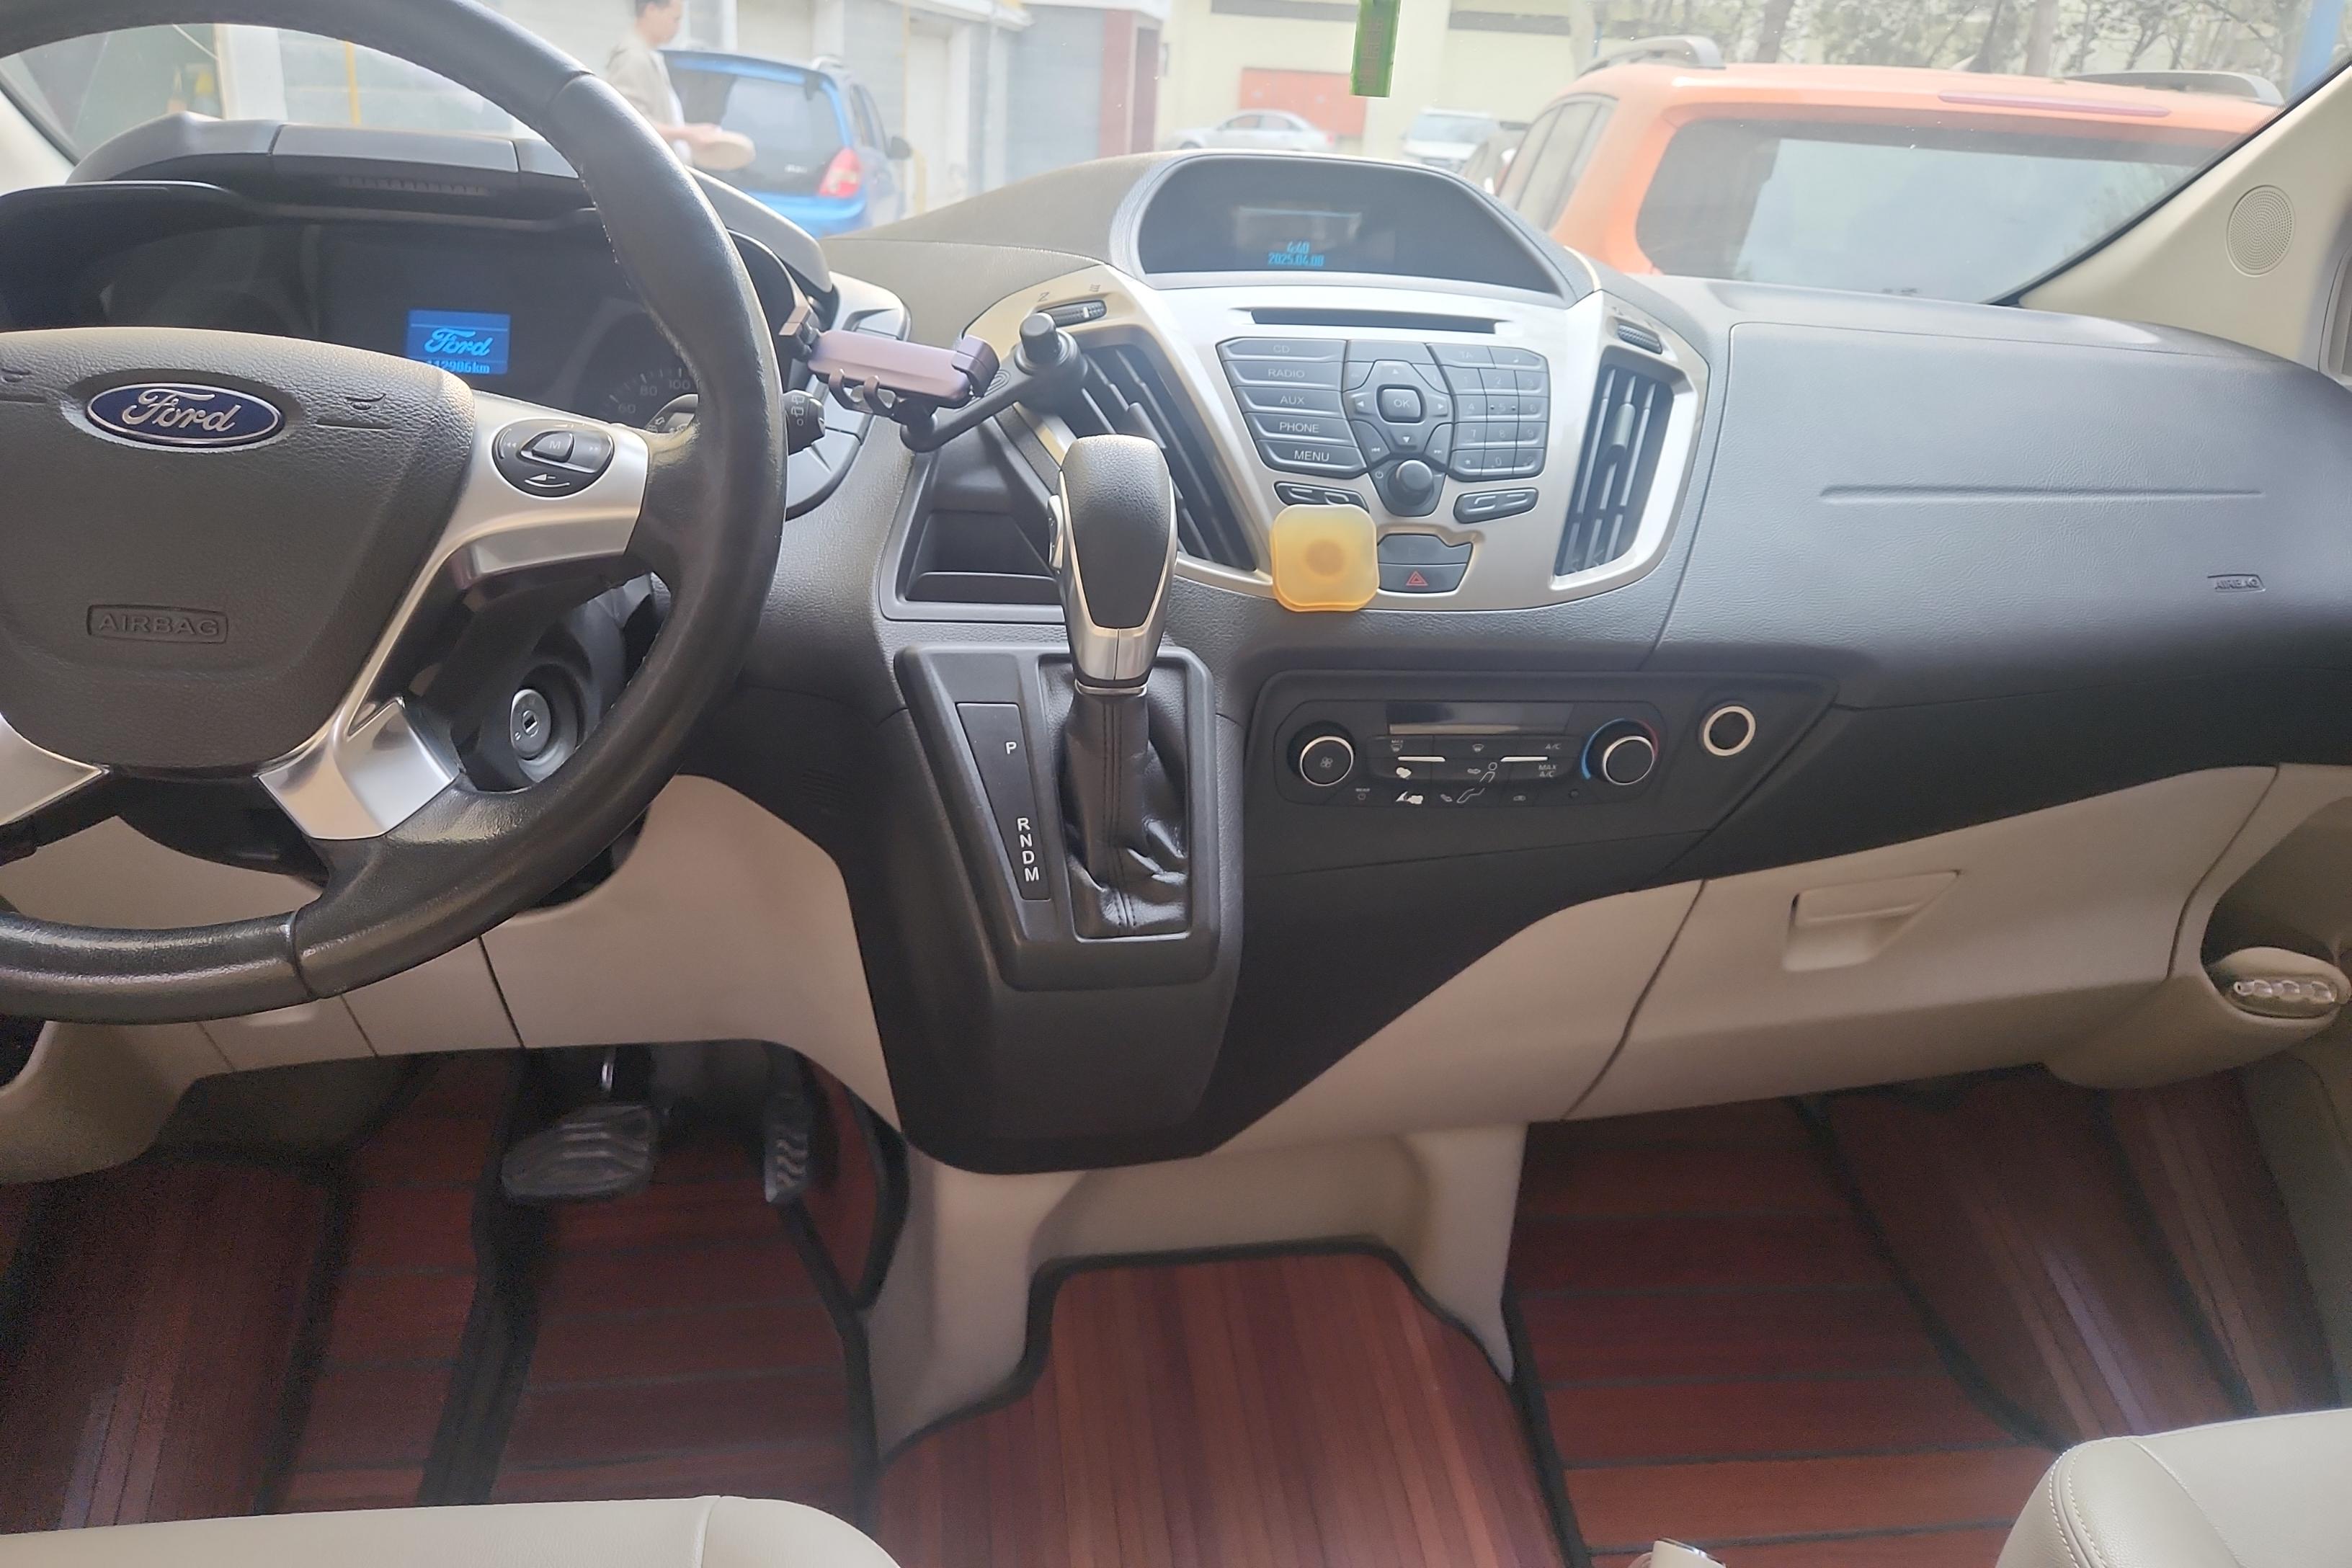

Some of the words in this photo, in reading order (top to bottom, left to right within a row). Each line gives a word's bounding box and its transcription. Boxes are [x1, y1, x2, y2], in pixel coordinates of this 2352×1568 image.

[424, 328, 493, 356] Ford
[1273, 345, 1291, 354] CD
[1268, 368, 1305, 378] RADIO
[669, 379, 690, 391] 100
[1495, 376, 1502, 386] 2
[640, 385, 658, 396] 80
[1280, 396, 1305, 405] AUX
[1393, 398, 1410, 408] OK
[122, 388, 241, 432] Ford
[1279, 422, 1320, 433] PHONE
[1471, 429, 1476, 438] 7
[1499, 430, 1506, 439] 8
[1527, 429, 1534, 438] 9
[548, 440, 561, 450] M
[1293, 450, 1330, 462] MENU
[1494, 457, 1502, 466] 0
[99, 613, 218, 636] AIRBAG
[1005, 741, 1017, 755] P
[1017, 817, 1030, 832] R
[1020, 833, 1033, 848] N
[1022, 850, 1035, 865] D
[1025, 866, 1040, 883] M
